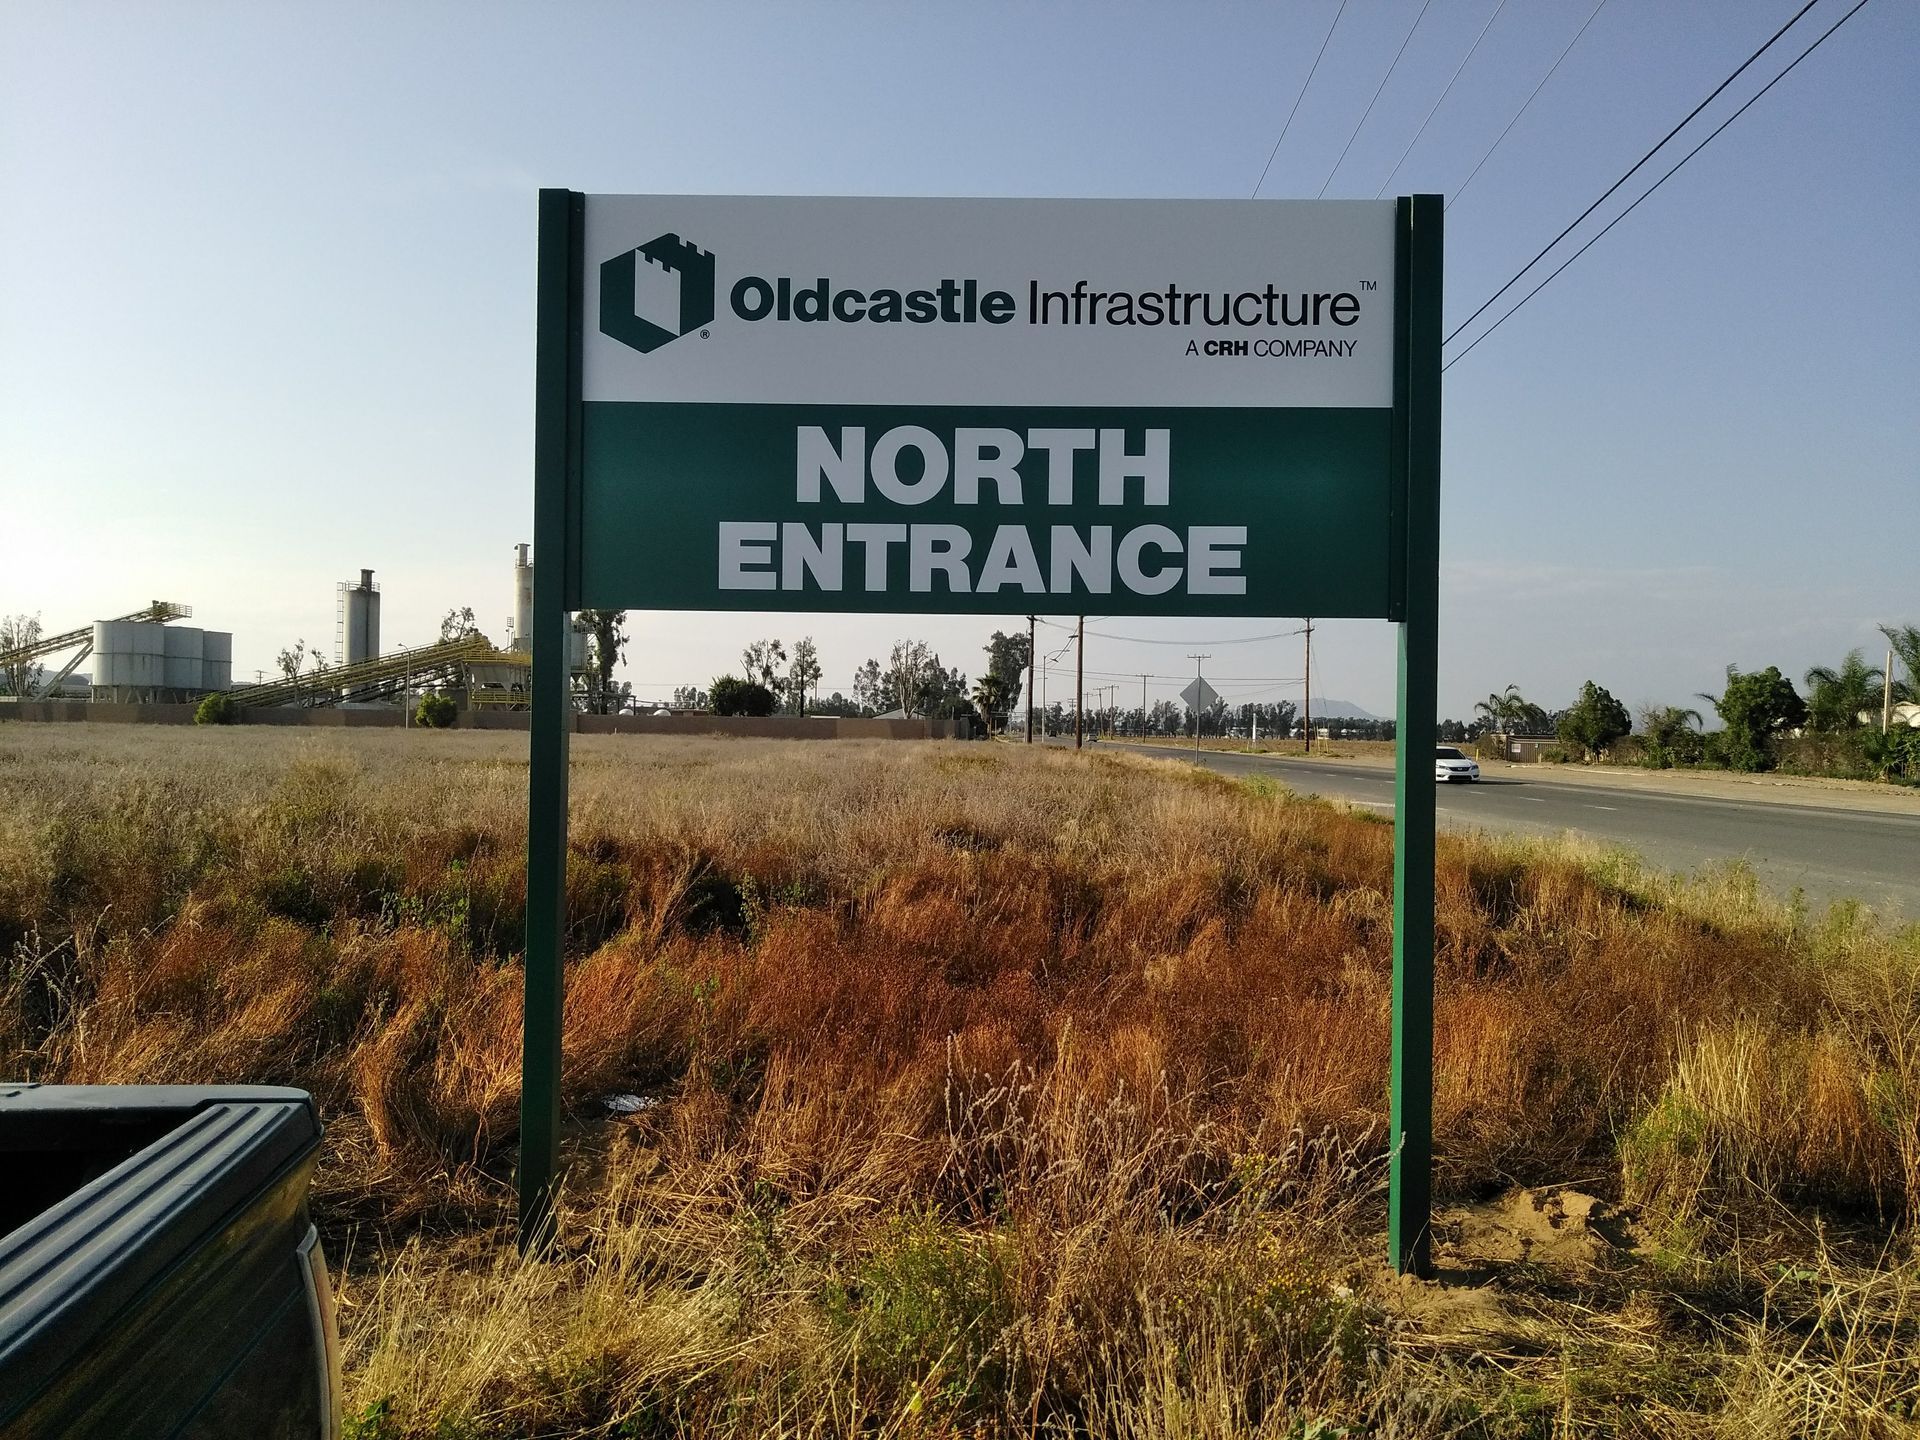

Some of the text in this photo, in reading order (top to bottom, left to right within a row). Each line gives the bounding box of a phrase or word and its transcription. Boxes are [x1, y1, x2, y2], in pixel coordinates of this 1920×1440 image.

[730, 276, 1016, 325] Oldcastle
[1029, 279, 1361, 327] Infrastructure
[1185, 339, 1358, 358] A CRH COMPANY
[796, 425, 1171, 506] NORTH
[718, 521, 1248, 596] ENTRANCE
